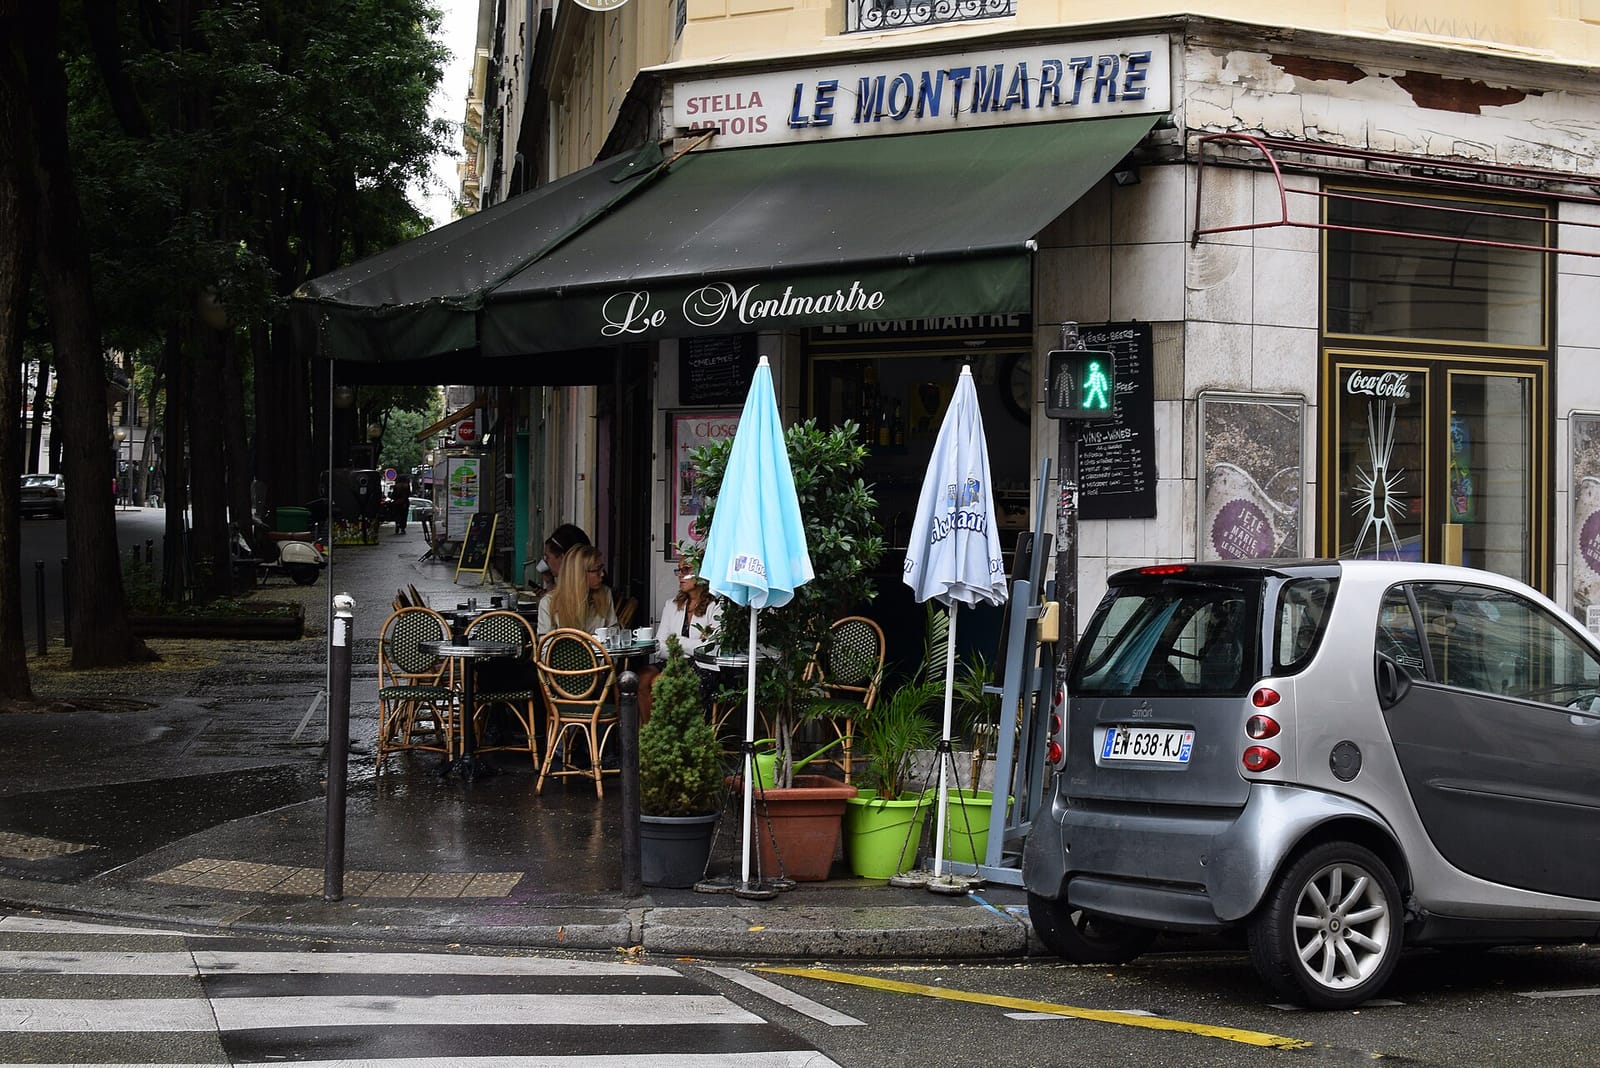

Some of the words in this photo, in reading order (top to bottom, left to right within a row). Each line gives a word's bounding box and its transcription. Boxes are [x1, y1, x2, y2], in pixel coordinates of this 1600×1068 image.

[788, 79, 839, 129] LE
[853, 50, 1152, 124] MONTMARTRE
[686, 91, 764, 115] STELLA
[600, 290, 667, 337] Le
[682, 280, 886, 328] Montmartre
[1347, 370, 1408, 397] Coca-Cola
[1231, 525, 1258, 549] MARIE
[1132, 708, 1153, 718] smart
